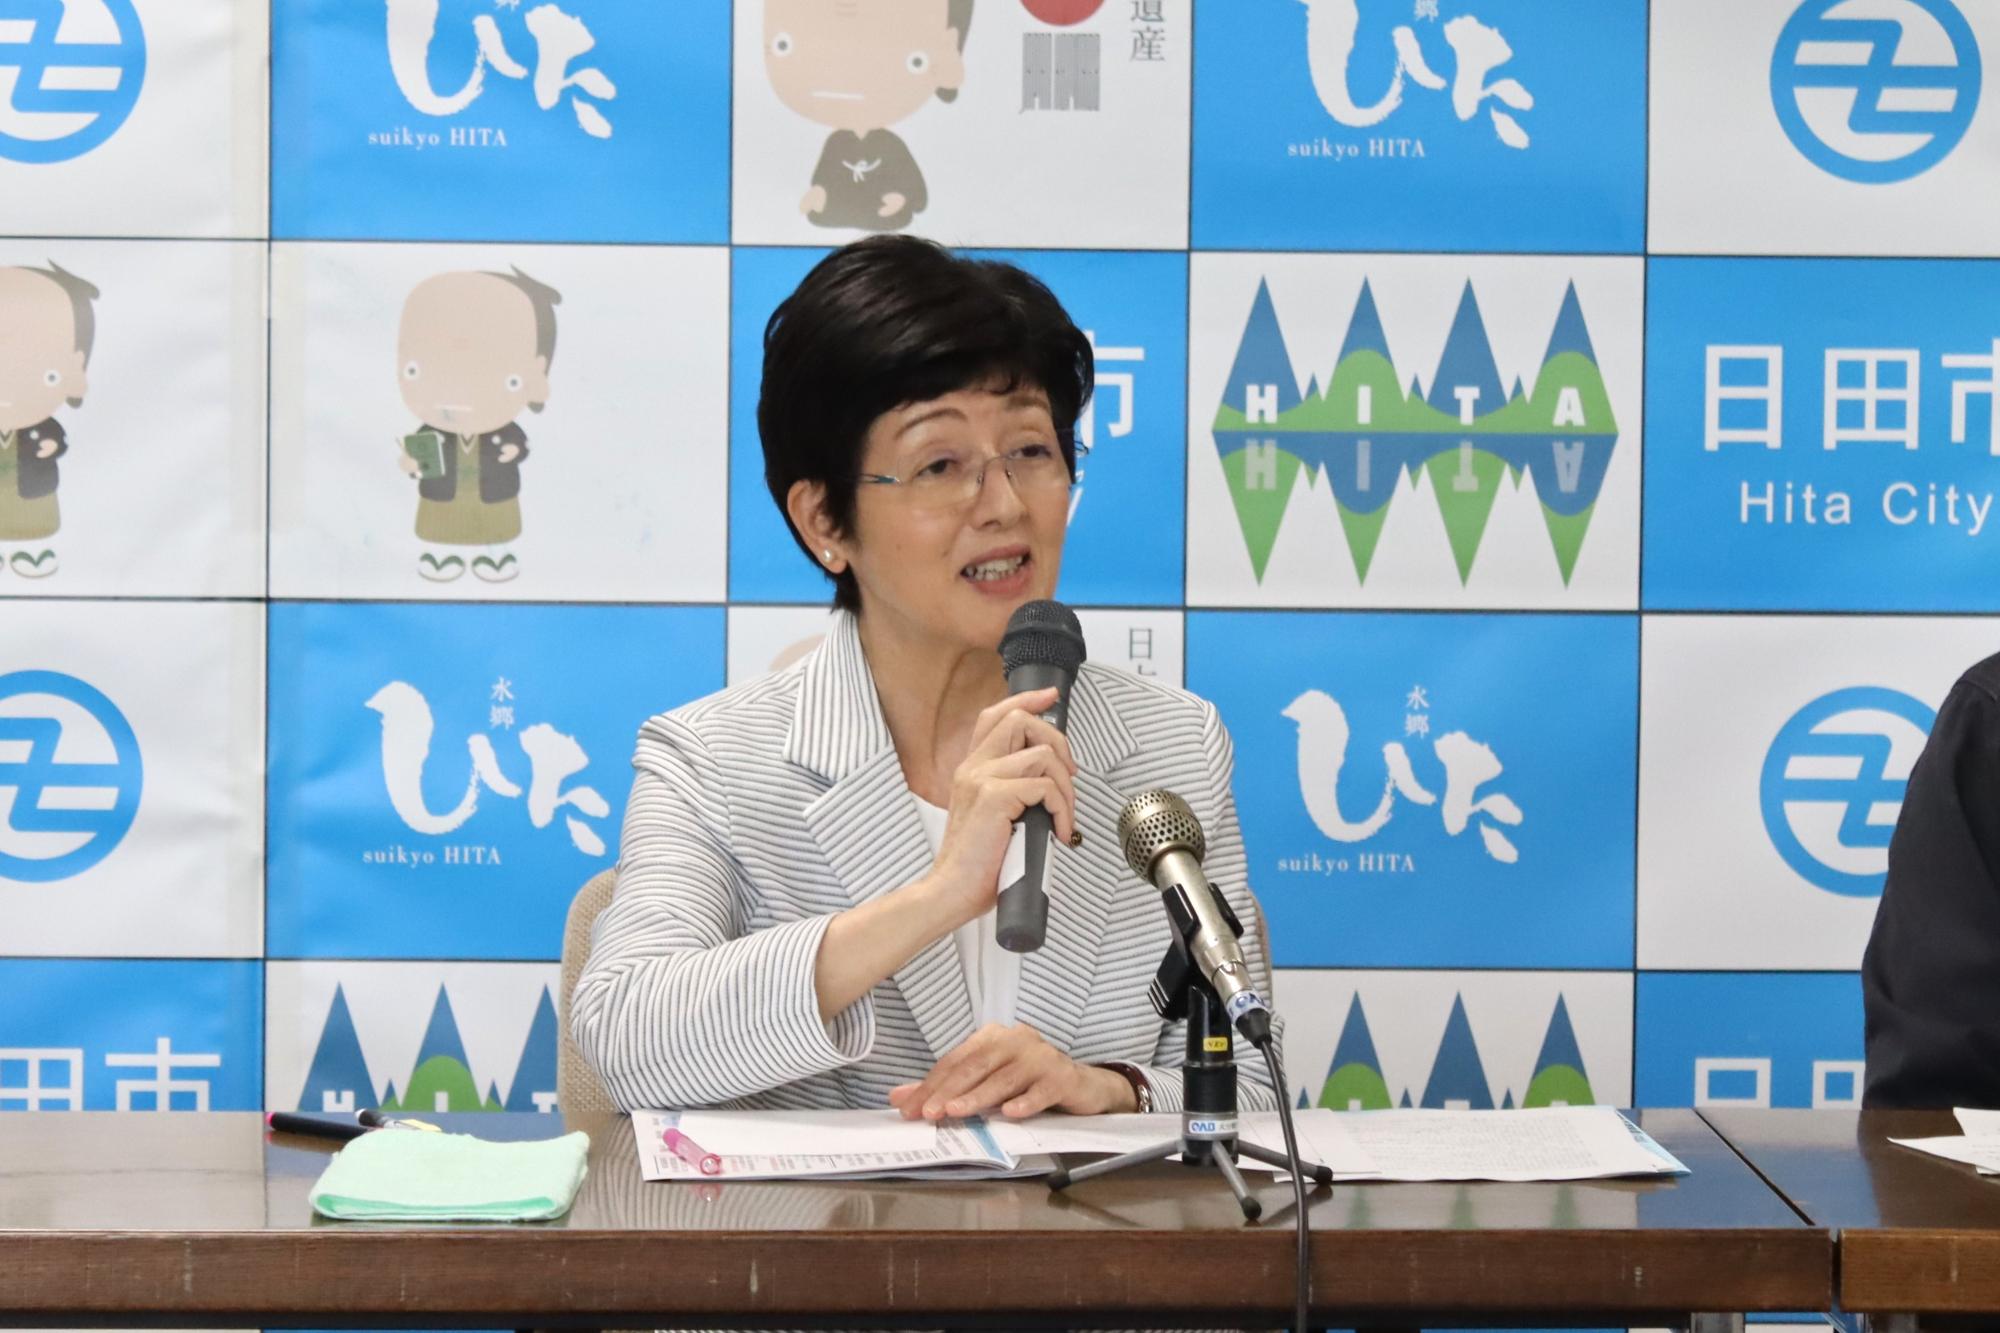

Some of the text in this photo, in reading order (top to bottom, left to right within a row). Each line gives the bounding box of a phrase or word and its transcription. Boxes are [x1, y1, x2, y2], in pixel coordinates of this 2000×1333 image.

[368, 127, 508, 150] suikyo HITA
[1287, 138, 1426, 161] suikyo HITA
[1245, 384, 1586, 427] HITA
[1740, 481, 1993, 536] Hita City
[362, 845, 502, 868] suikyo HITA
[1277, 853, 1416, 876] suikyo HITA
